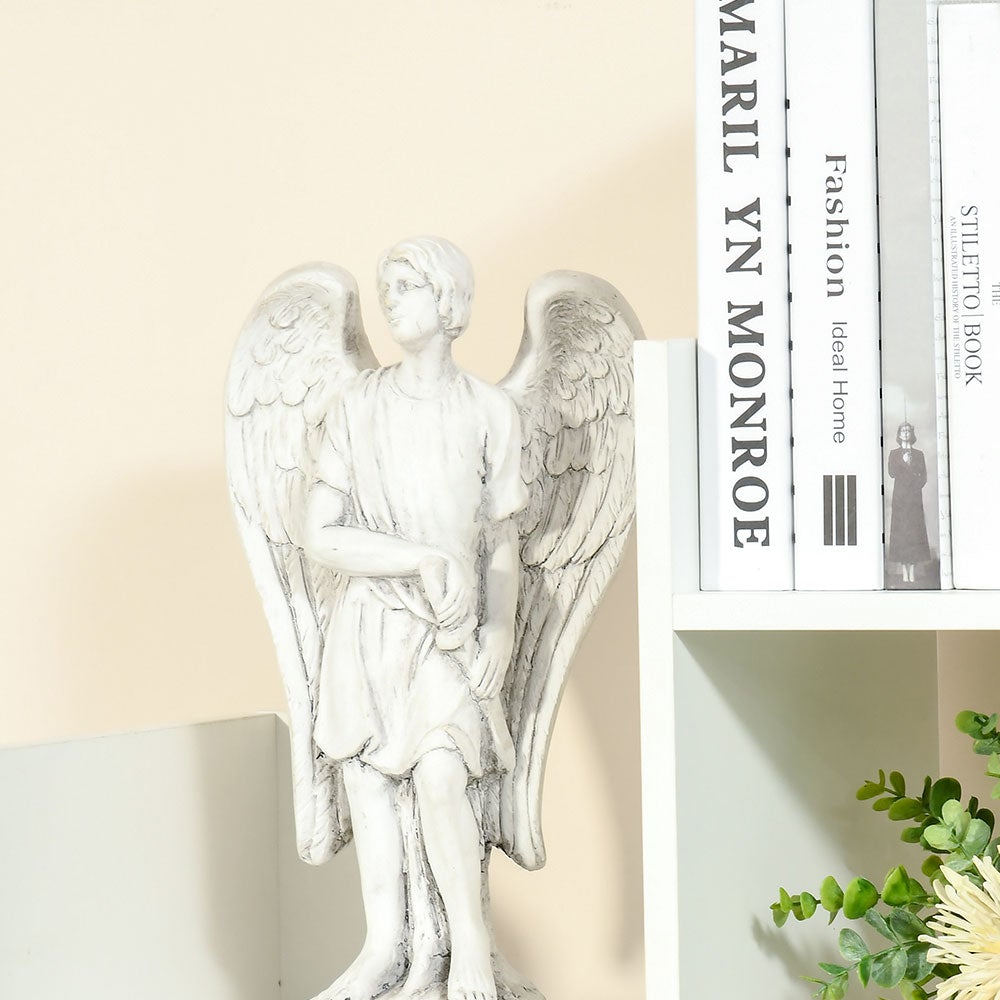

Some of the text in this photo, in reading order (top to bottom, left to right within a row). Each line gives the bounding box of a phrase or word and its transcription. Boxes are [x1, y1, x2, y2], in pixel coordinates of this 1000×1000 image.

[724, 197, 764, 275] YN
[824, 154, 849, 444] Fashion Ideal Home
[960, 205, 983, 386] STILETTO BOOK
[728, 301, 770, 548] MONROE
